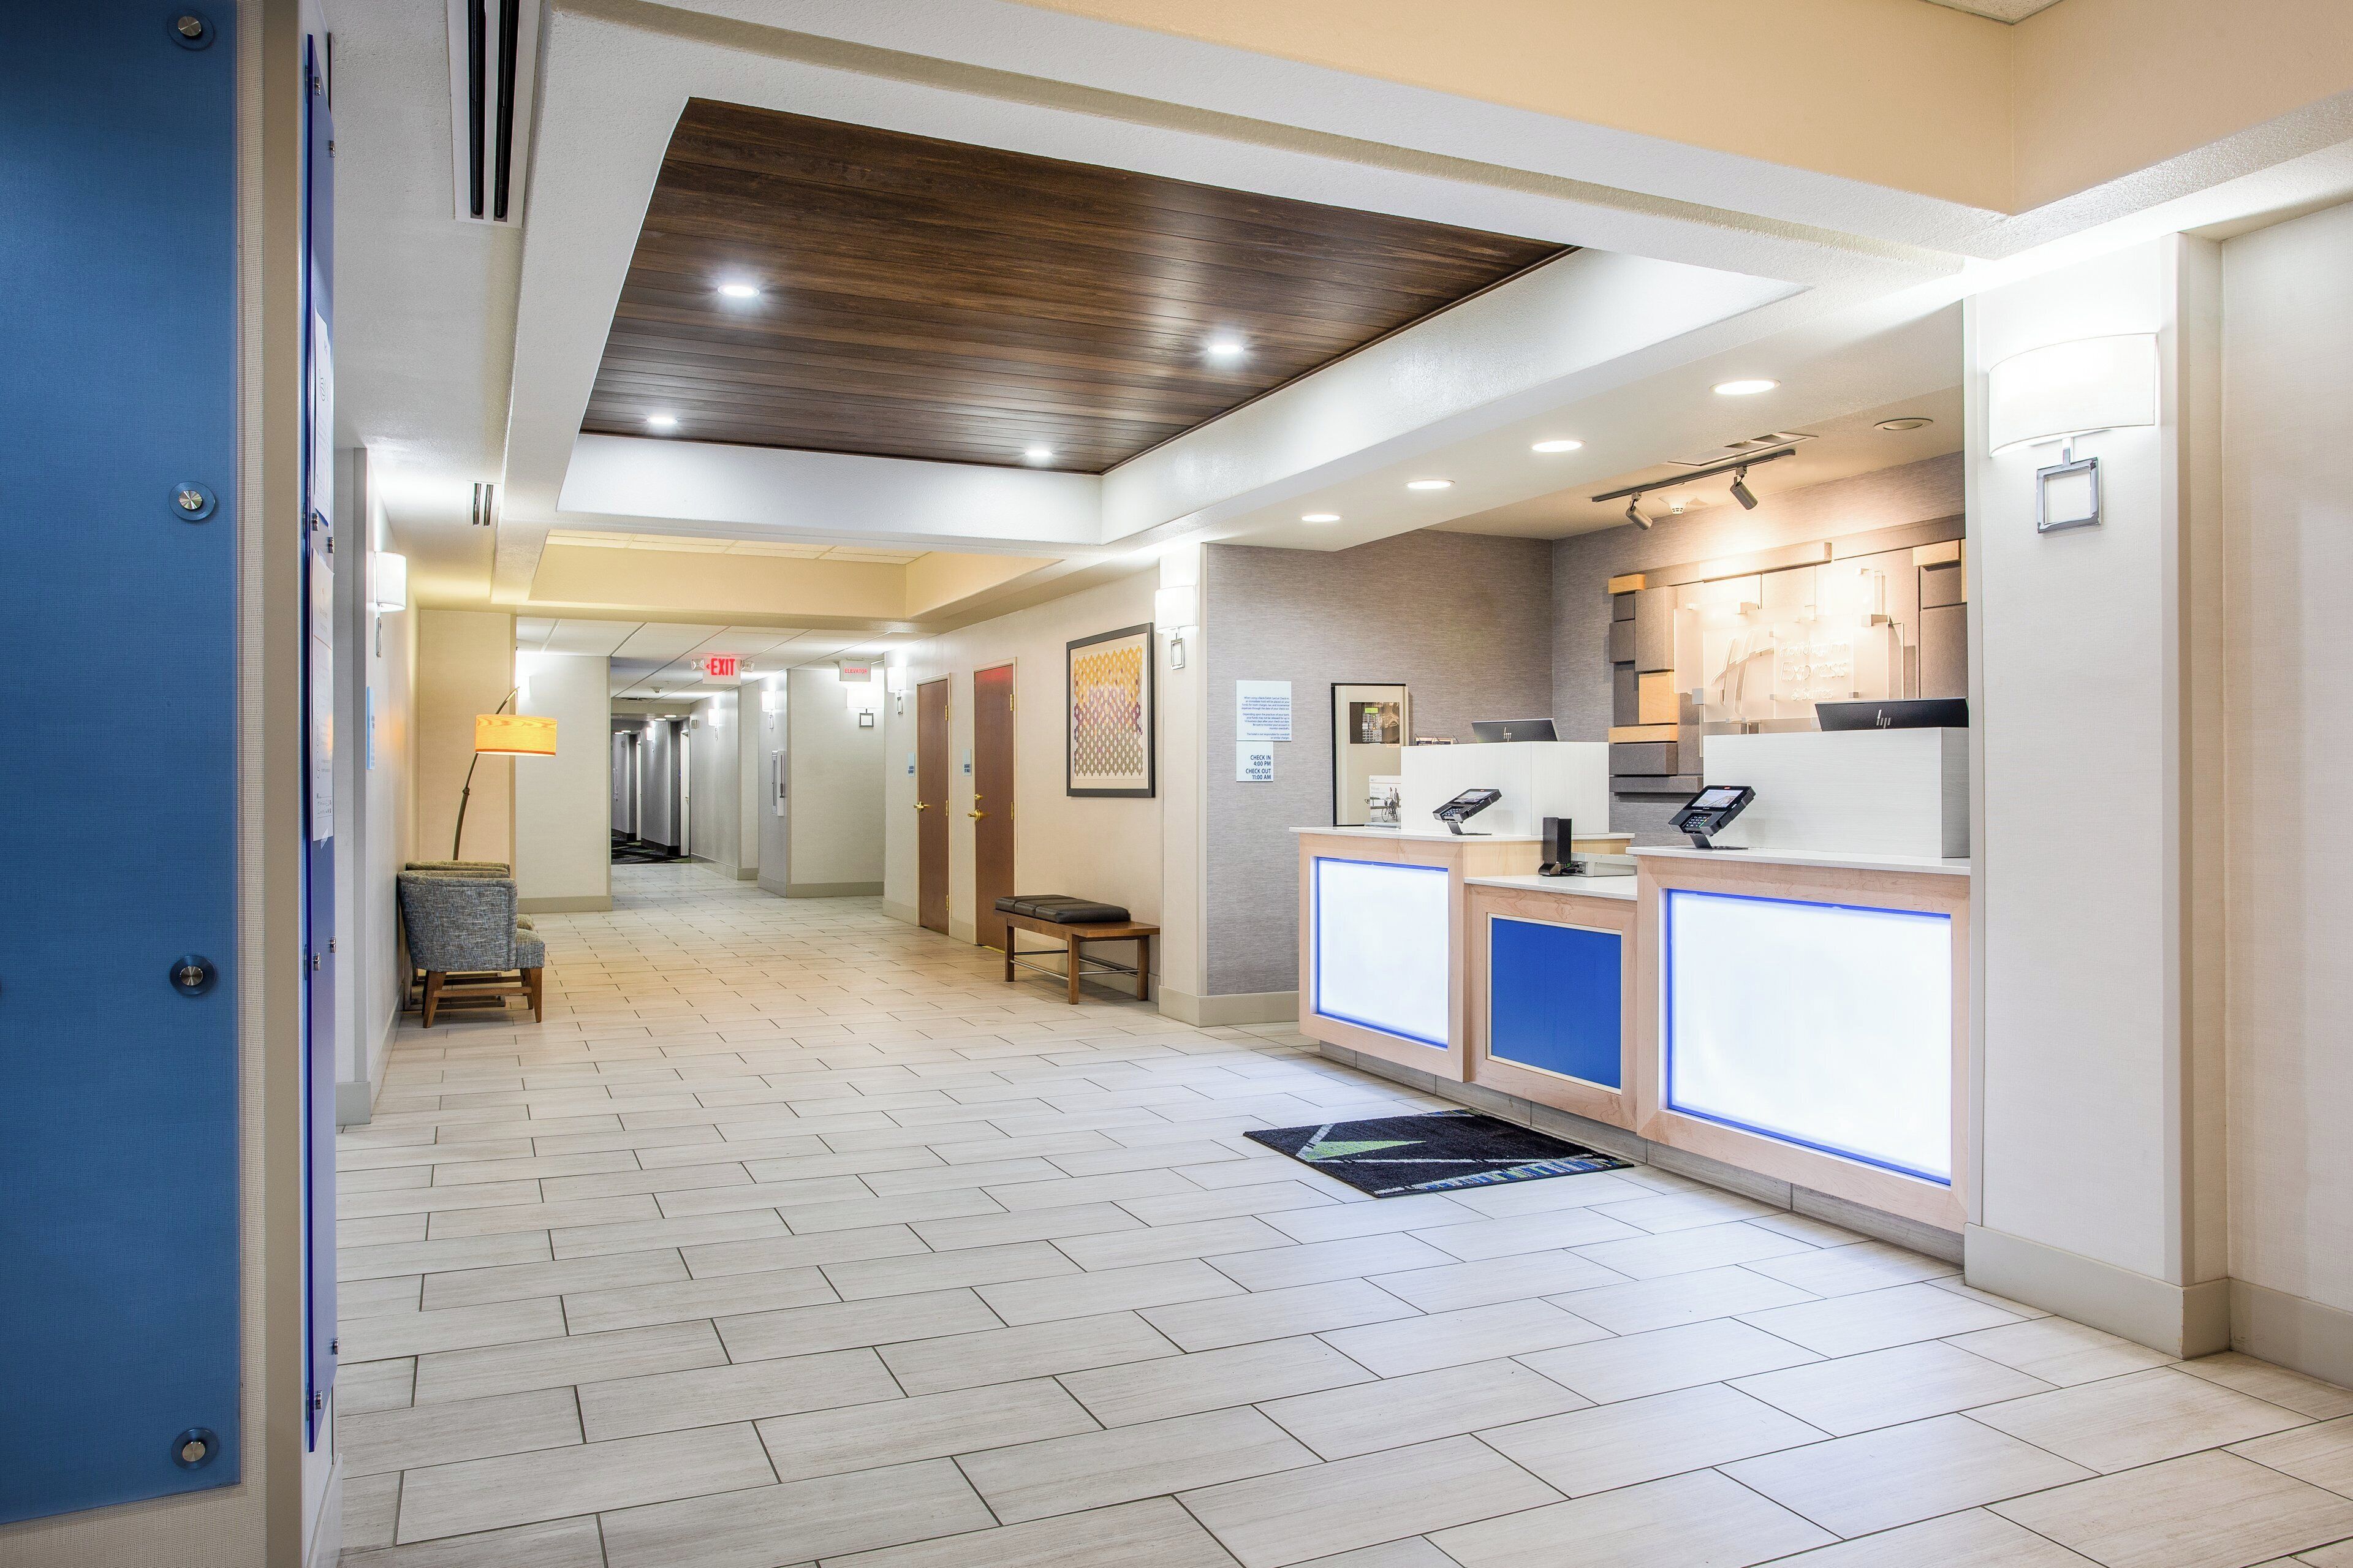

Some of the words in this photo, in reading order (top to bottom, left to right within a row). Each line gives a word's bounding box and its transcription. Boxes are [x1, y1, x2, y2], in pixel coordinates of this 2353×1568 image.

[711, 658, 735, 676] EXIT
[1876, 709, 1891, 729] hp
[1503, 727, 1512, 742] hp
